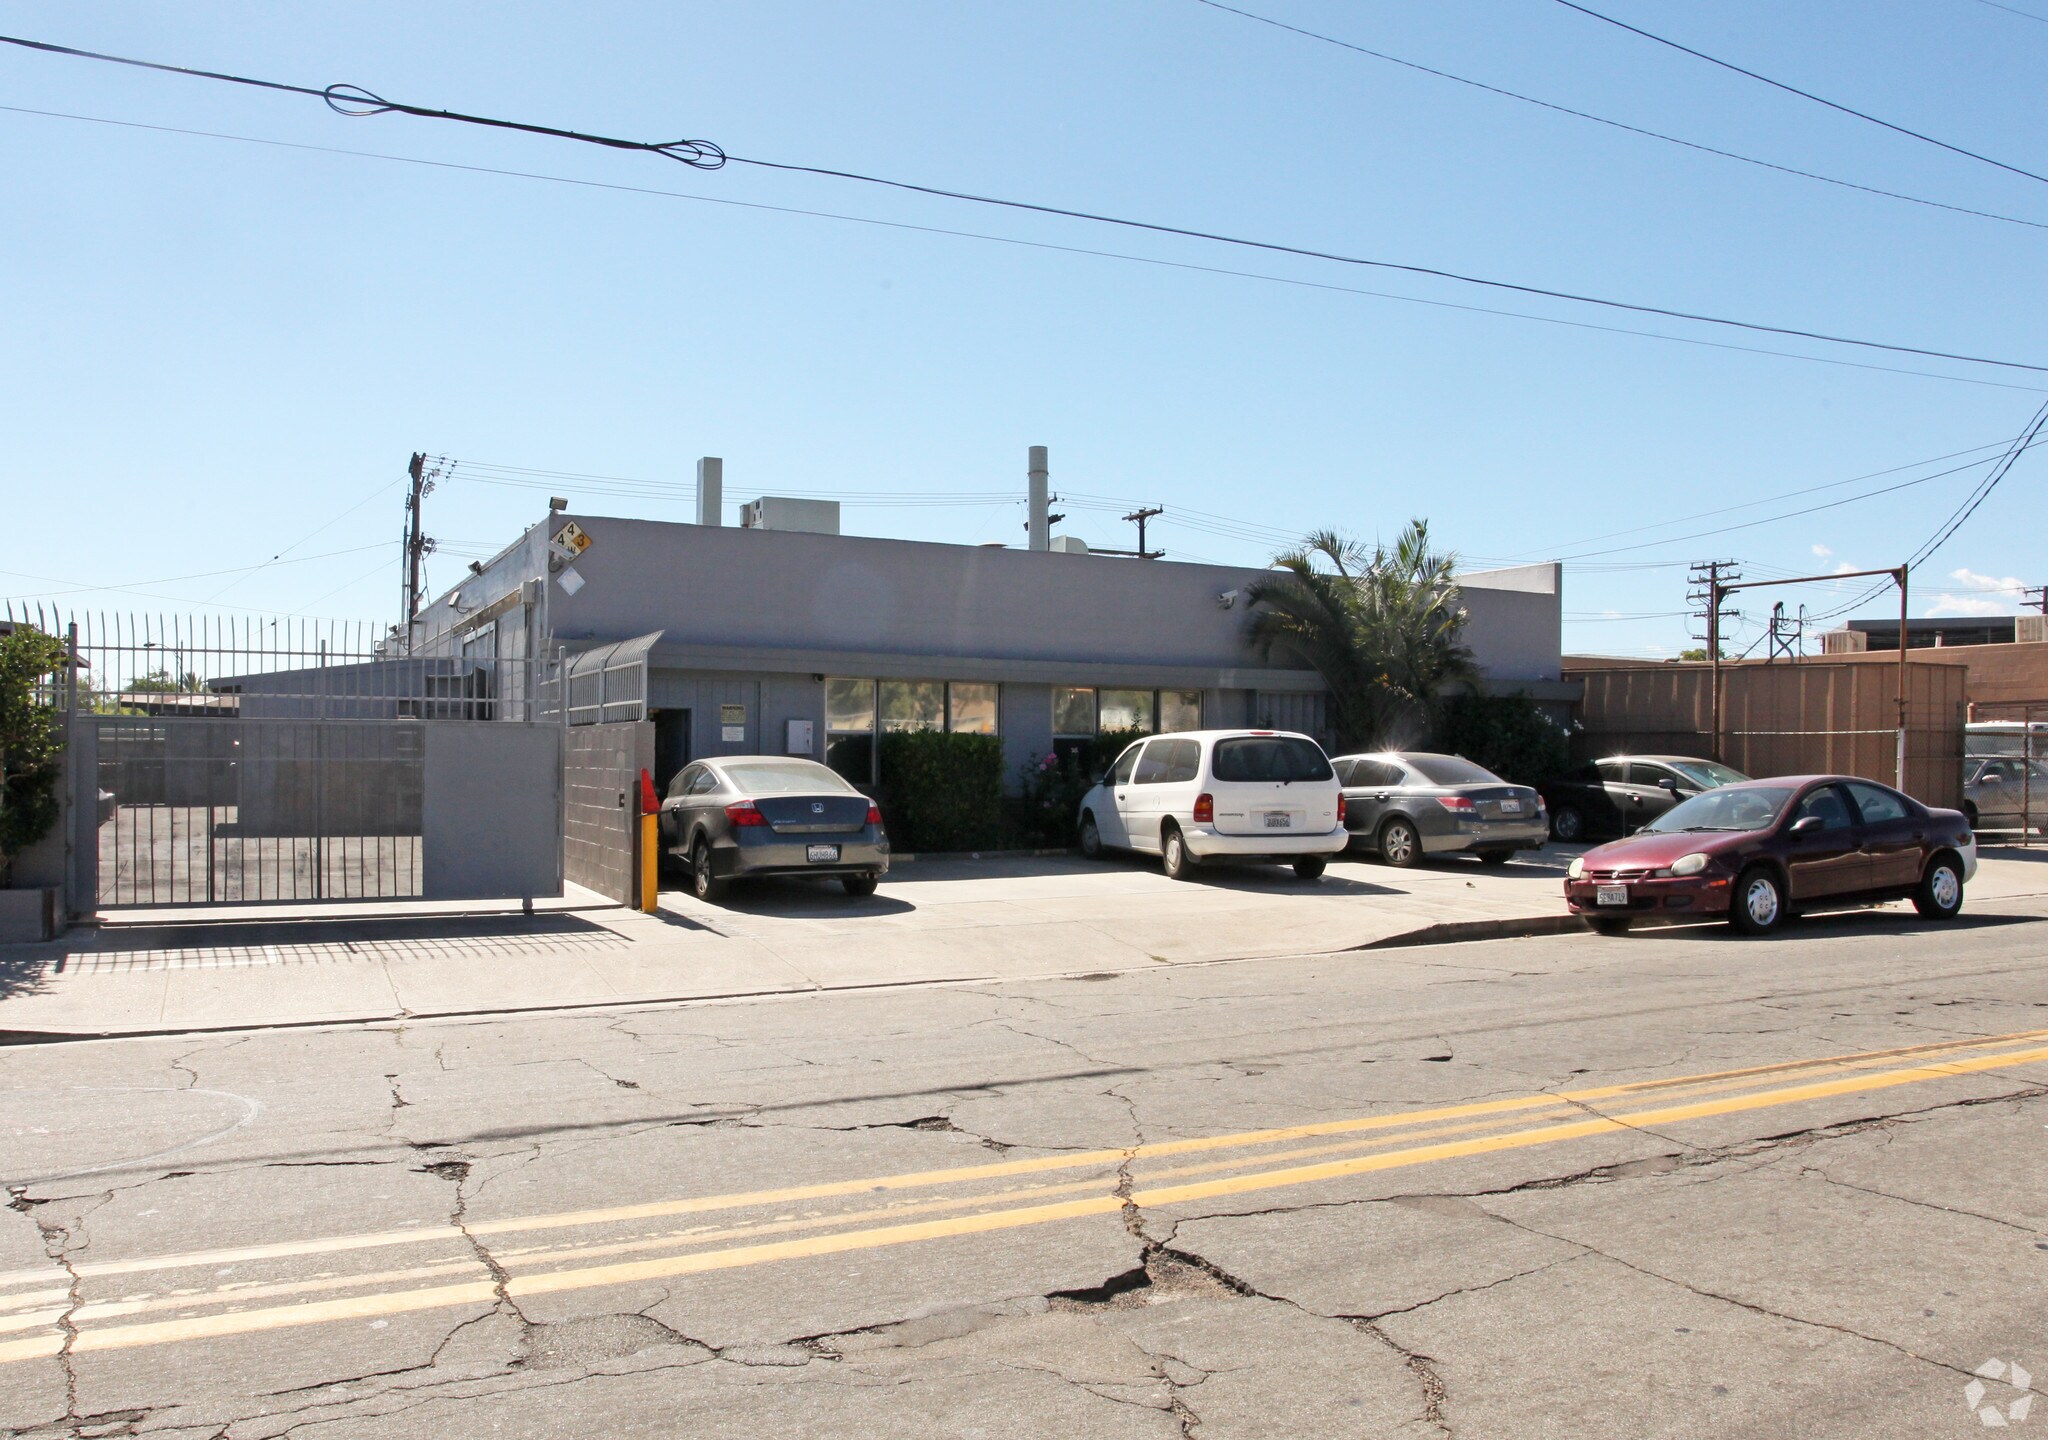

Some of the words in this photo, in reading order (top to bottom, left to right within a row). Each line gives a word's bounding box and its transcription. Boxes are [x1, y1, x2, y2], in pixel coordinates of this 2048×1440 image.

[567, 523, 575, 536] 4
[557, 533, 565, 546] 4
[577, 534, 585, 547] 3
